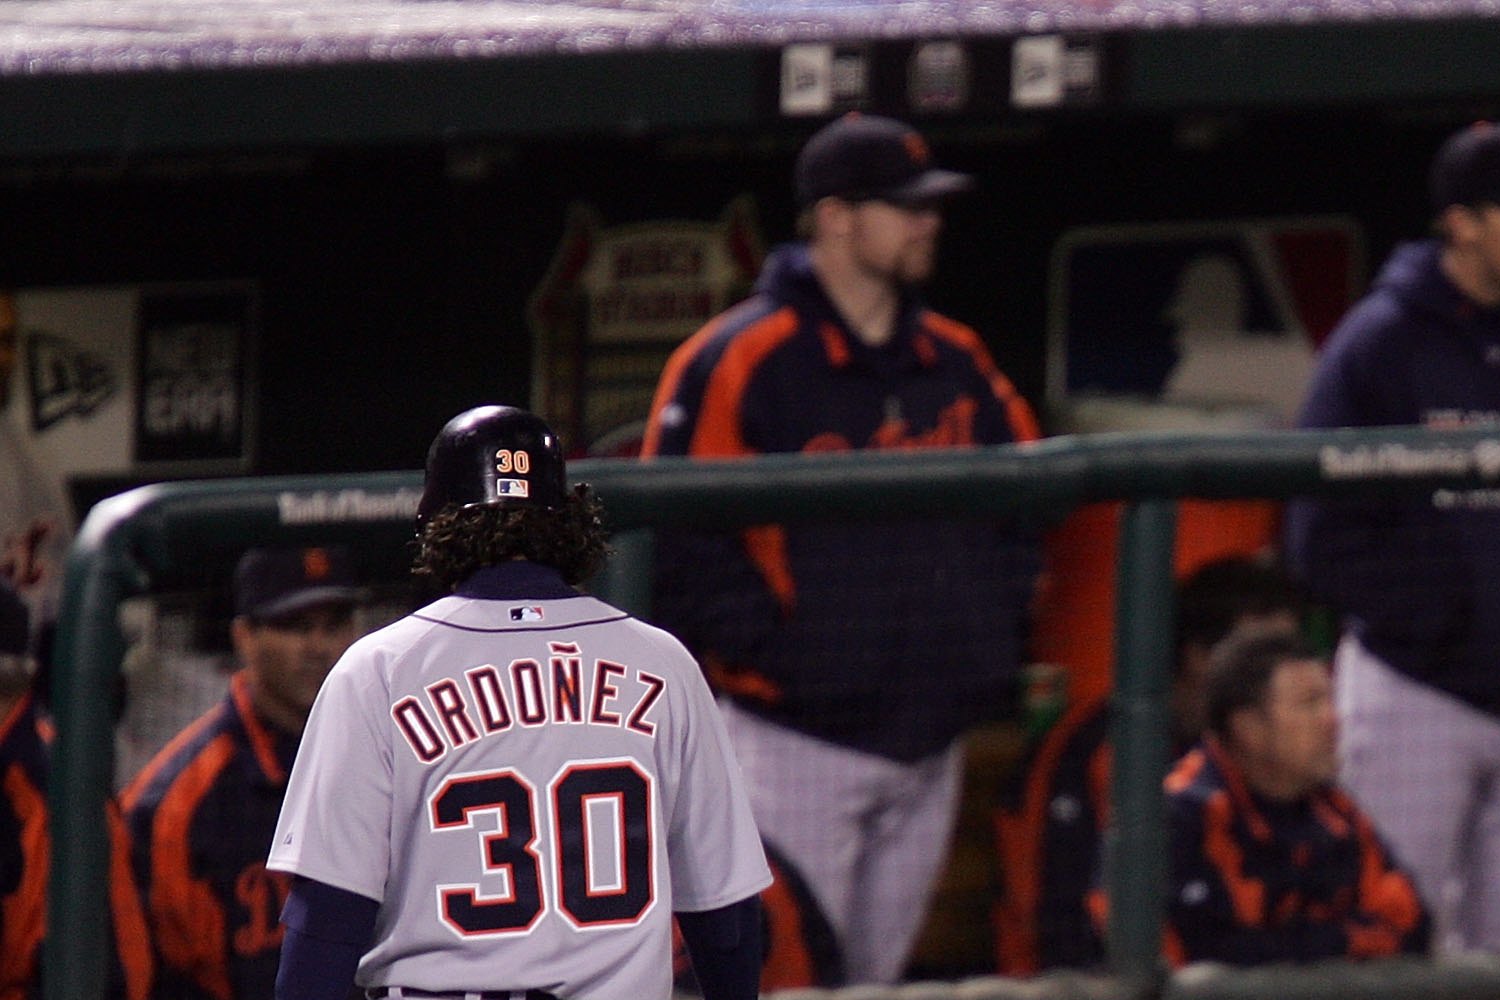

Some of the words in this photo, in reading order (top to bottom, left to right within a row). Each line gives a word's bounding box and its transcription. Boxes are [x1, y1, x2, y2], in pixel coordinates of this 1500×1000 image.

[496, 449, 531, 475] 30
[391, 641, 666, 763] ORDOÑEZ
[427, 756, 657, 940] 30
